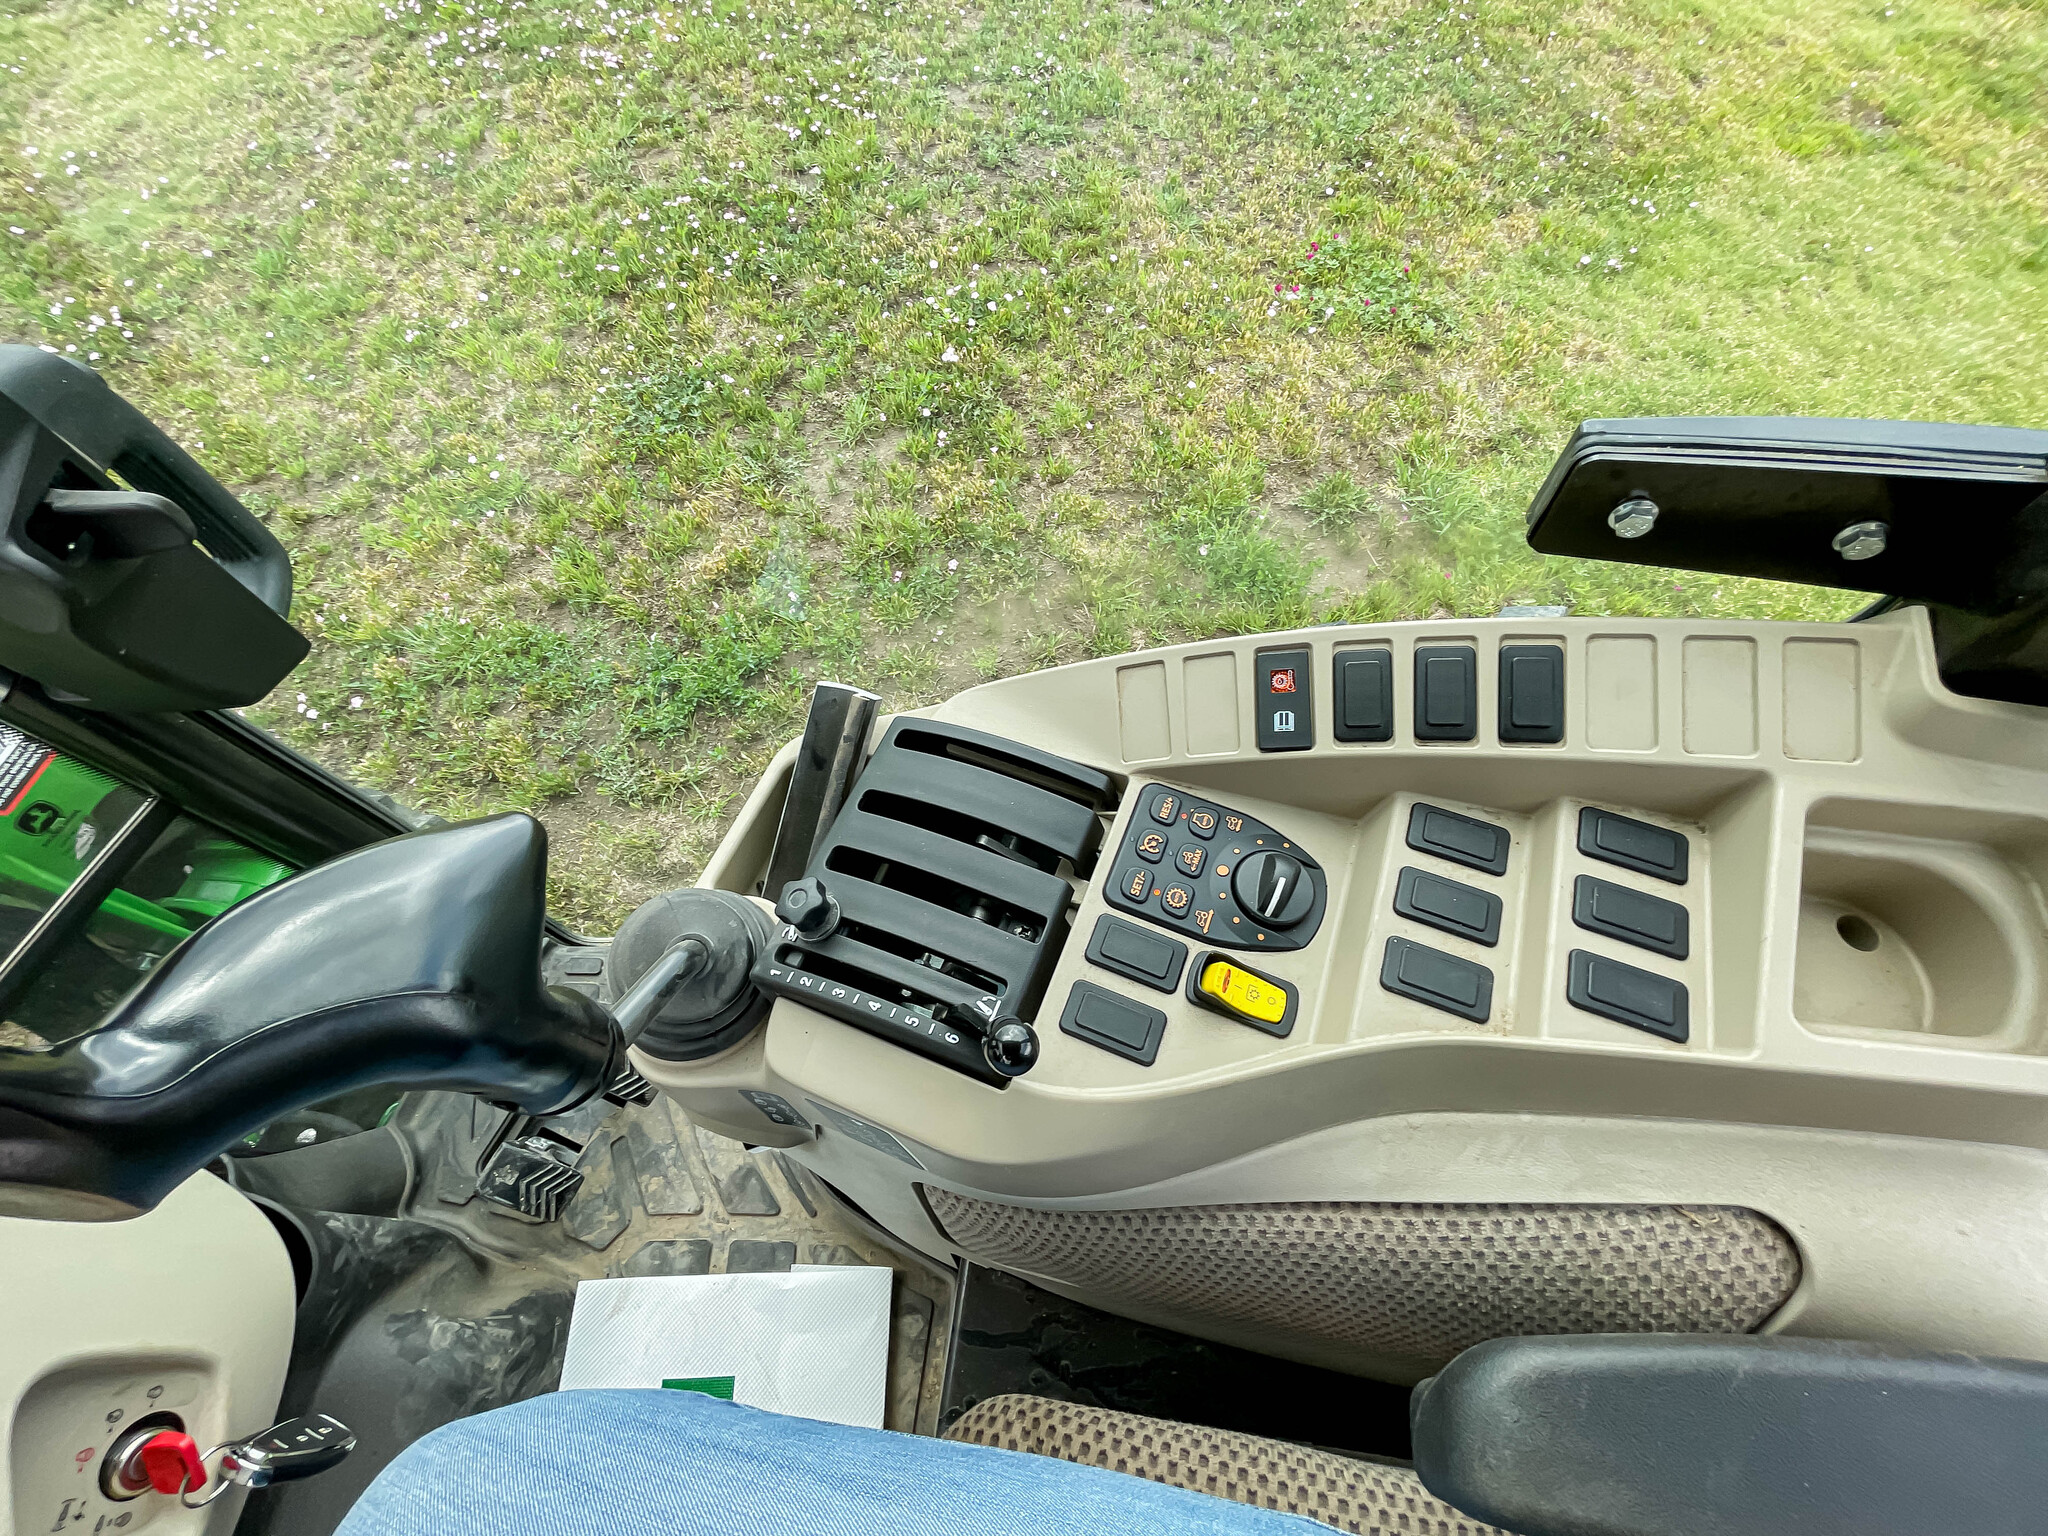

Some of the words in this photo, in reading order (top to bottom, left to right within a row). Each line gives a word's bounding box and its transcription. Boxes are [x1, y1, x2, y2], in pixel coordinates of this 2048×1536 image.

[1192, 848, 1203, 865] MAX
[769, 968, 782, 976] 1
[799, 976, 813, 988] 2
[832, 987, 846, 999] 3
[868, 1000, 882, 1012] 4
[904, 1016, 920, 1028] 5
[944, 1032, 960, 1045] 6
